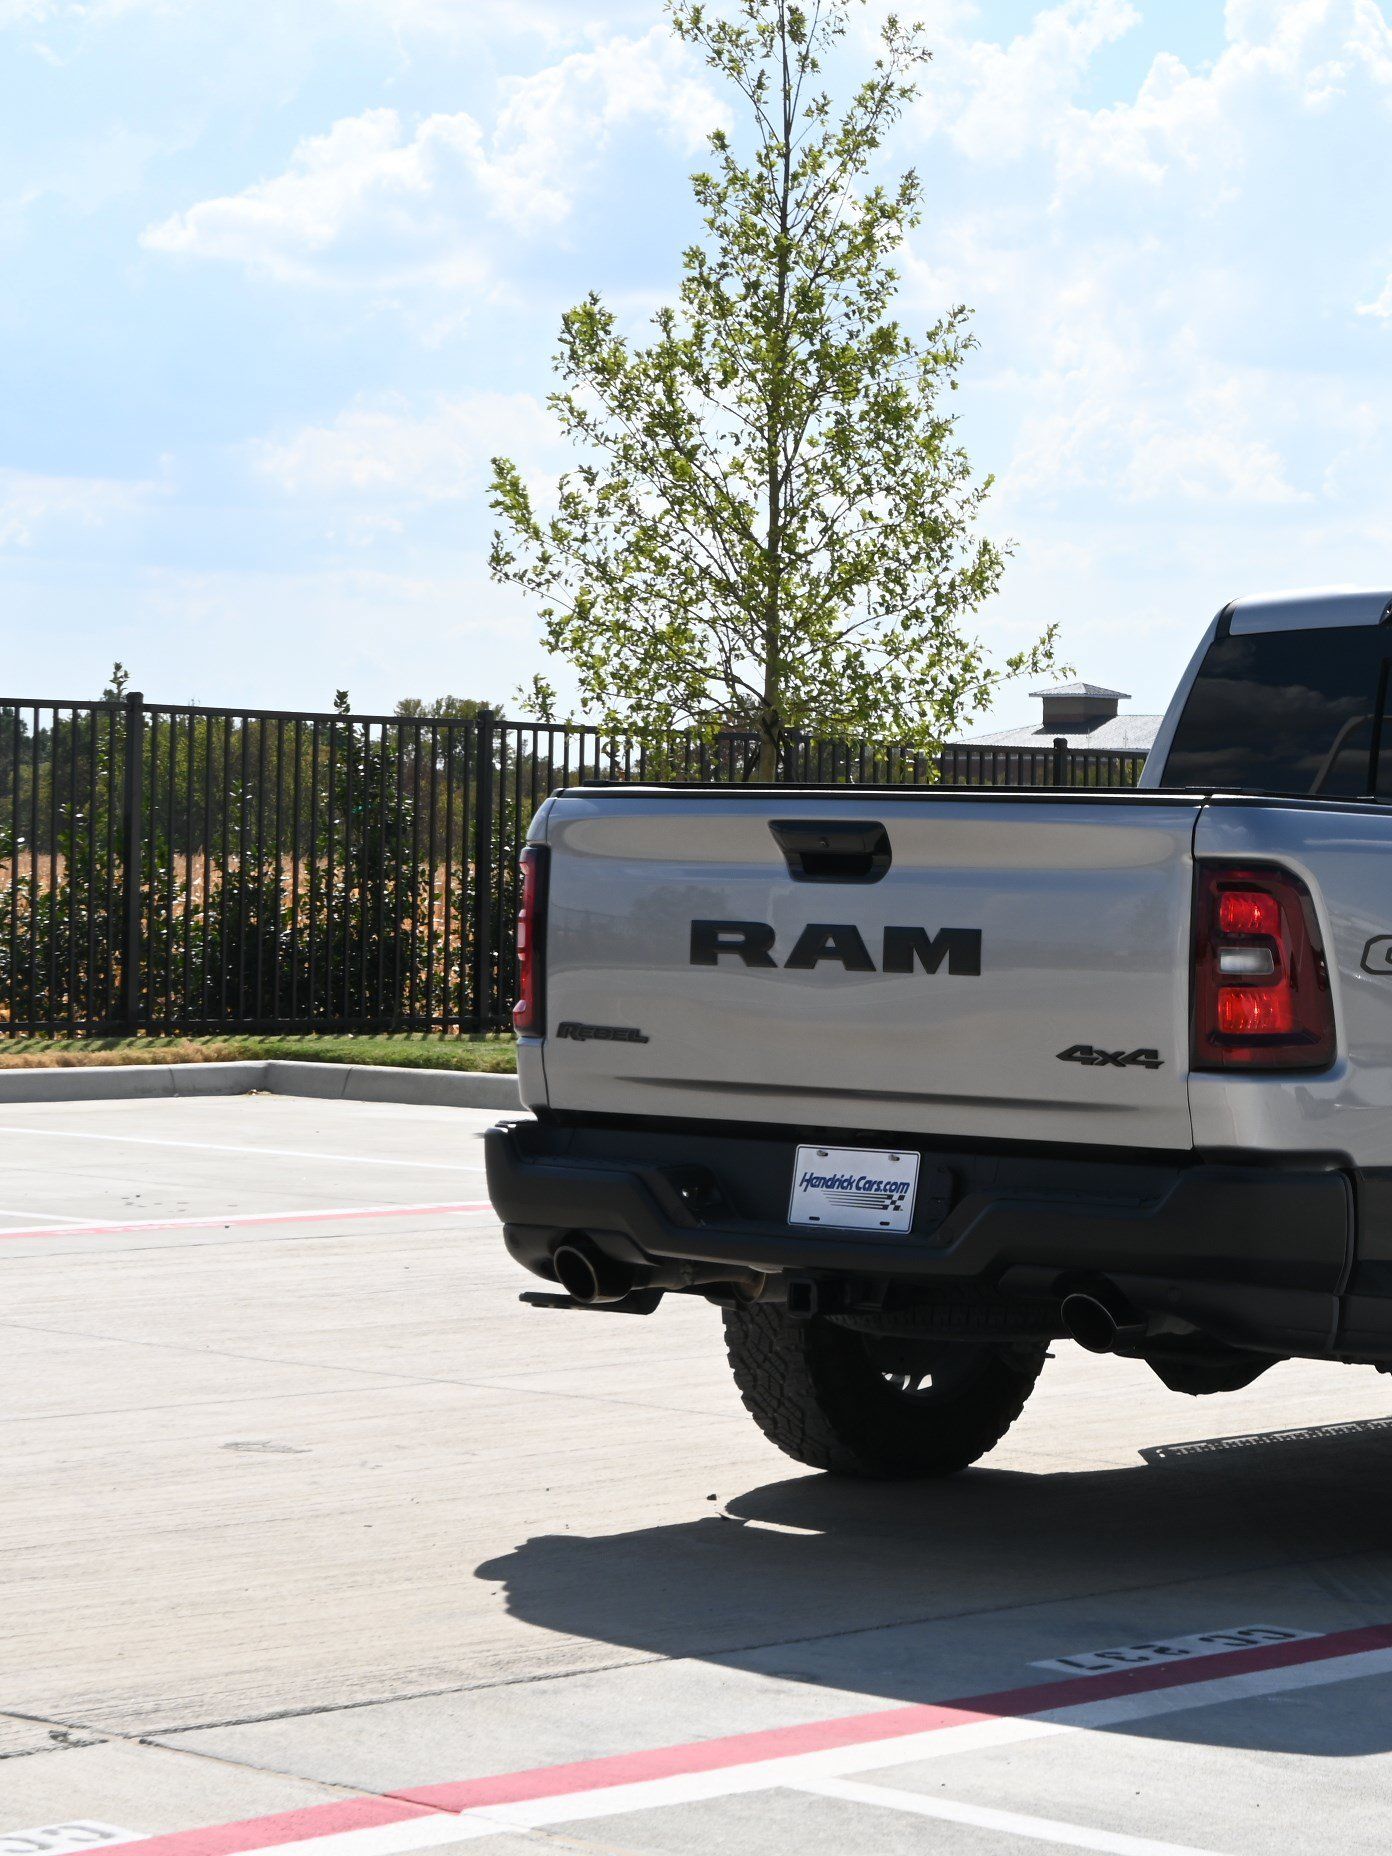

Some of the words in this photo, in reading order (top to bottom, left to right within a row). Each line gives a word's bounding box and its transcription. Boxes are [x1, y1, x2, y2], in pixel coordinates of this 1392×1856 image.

[690, 919, 982, 976] RAM
[556, 1021, 650, 1044] REBEL
[1198, 1628, 1297, 1648] CC
[1057, 1644, 1191, 1671] 237
